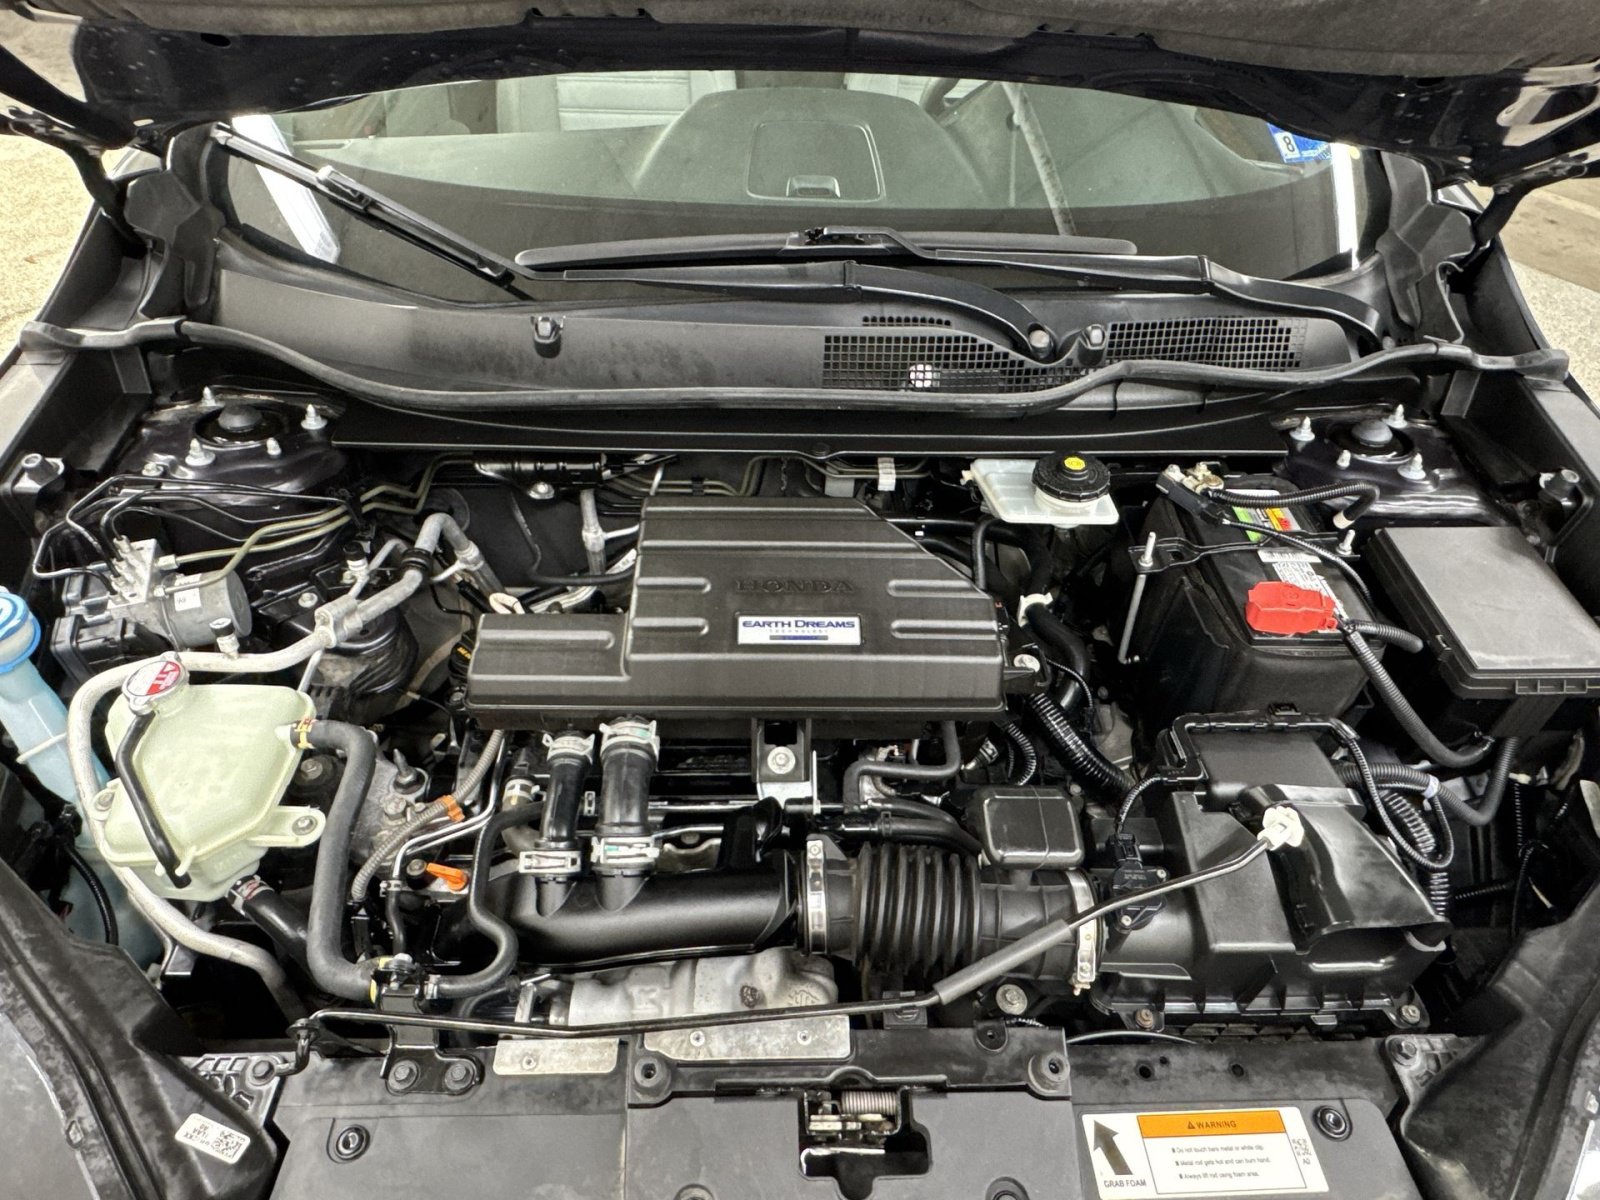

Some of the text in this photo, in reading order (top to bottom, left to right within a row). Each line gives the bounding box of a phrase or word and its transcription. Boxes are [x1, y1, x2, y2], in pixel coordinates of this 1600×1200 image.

[1283, 135, 1295, 152] 8
[735, 579, 856, 593] HONDA
[742, 619, 855, 628] EARTH DREAMS
[1195, 1120, 1237, 1129] WARNING
[1103, 1178, 1147, 1188] GRAB FOAM
